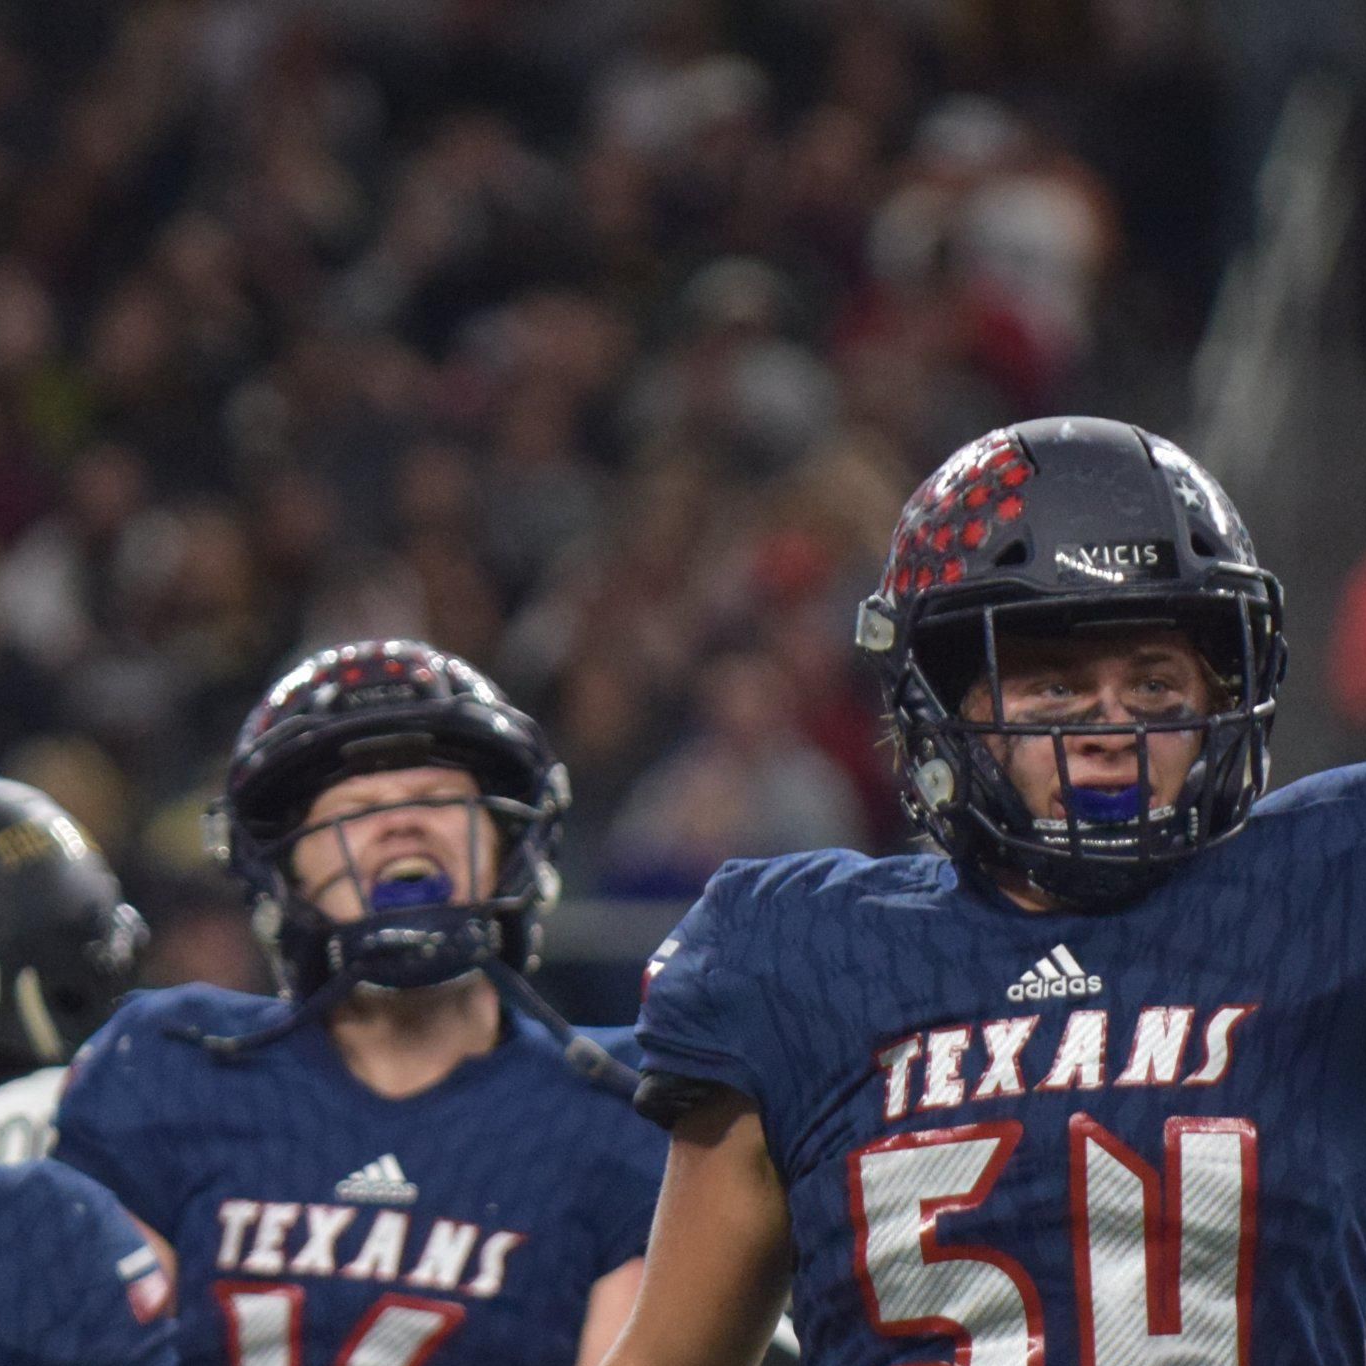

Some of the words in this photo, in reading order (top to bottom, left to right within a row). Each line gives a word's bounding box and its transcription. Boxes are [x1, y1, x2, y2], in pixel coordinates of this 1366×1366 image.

[1078, 544, 1159, 565] VICIS
[1006, 974, 1103, 1002] adidas
[873, 1003, 1259, 1122] TEXANS
[215, 1199, 529, 1299] TEXANS
